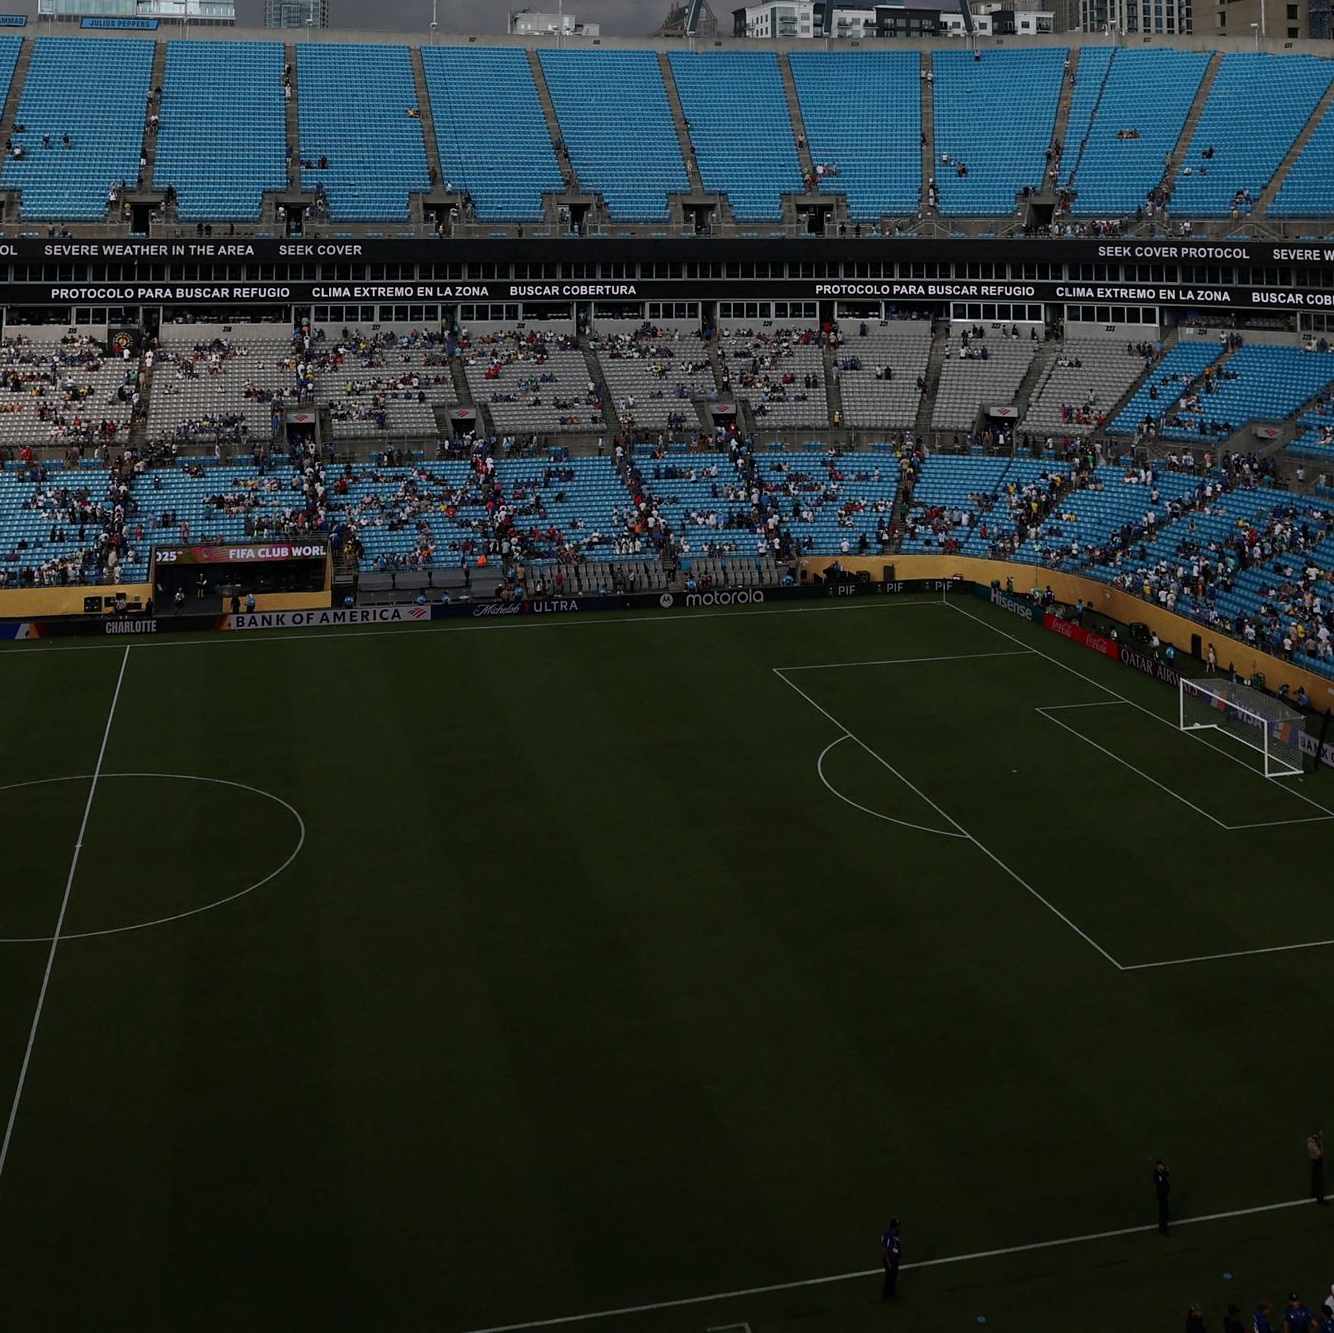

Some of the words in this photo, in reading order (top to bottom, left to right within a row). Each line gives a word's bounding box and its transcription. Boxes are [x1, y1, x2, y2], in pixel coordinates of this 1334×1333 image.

[90, 19, 113, 27] JULIUS
[116, 20, 150, 28] PEPPERS
[45, 245, 98, 255] SEVERE
[103, 245, 167, 255] WEATHER
[172, 245, 185, 255] IN
[189, 245, 214, 255] THE
[218, 245, 254, 255] AREA
[279, 245, 313, 255] SEEK
[318, 245, 361, 255] COVER
[1099, 247, 1132, 256] SEEK
[1135, 247, 1178, 257] COVER
[1182, 248, 1250, 258] PROTOCOL
[1273, 249, 1320, 260] SEVERE
[815, 285, 890, 295] PROTOCOLO
[893, 285, 925, 295] PARA
[928, 285, 977, 296] BUSCAR
[981, 286, 1034, 296] REFUGIO
[1056, 287, 1094, 297] CLIMA
[1097, 288, 1155, 299] EXTREMO
[1159, 290, 1175, 299] EN
[1180, 290, 1194, 300] LA
[1197, 291, 1230, 301] ZONA
[1252, 292, 1303, 304] BUSCAR
[229, 548, 254, 560] FIFA
[258, 547, 289, 558] CLUB
[292, 545, 326, 557] WORL
[838, 586, 856, 596] PIF
[886, 583, 905, 593] PIF
[687, 589, 764, 607] motorola
[991, 588, 1033, 620] Hisense
[473, 603, 522, 618] Michelob
[534, 600, 578, 612] ULTRA
[236, 614, 286, 627] BANK
[292, 612, 313, 624] OF
[319, 608, 402, 624] AMERICA
[106, 620, 157, 634] CHARLOTTE
[1121, 647, 1154, 676] QATAR
